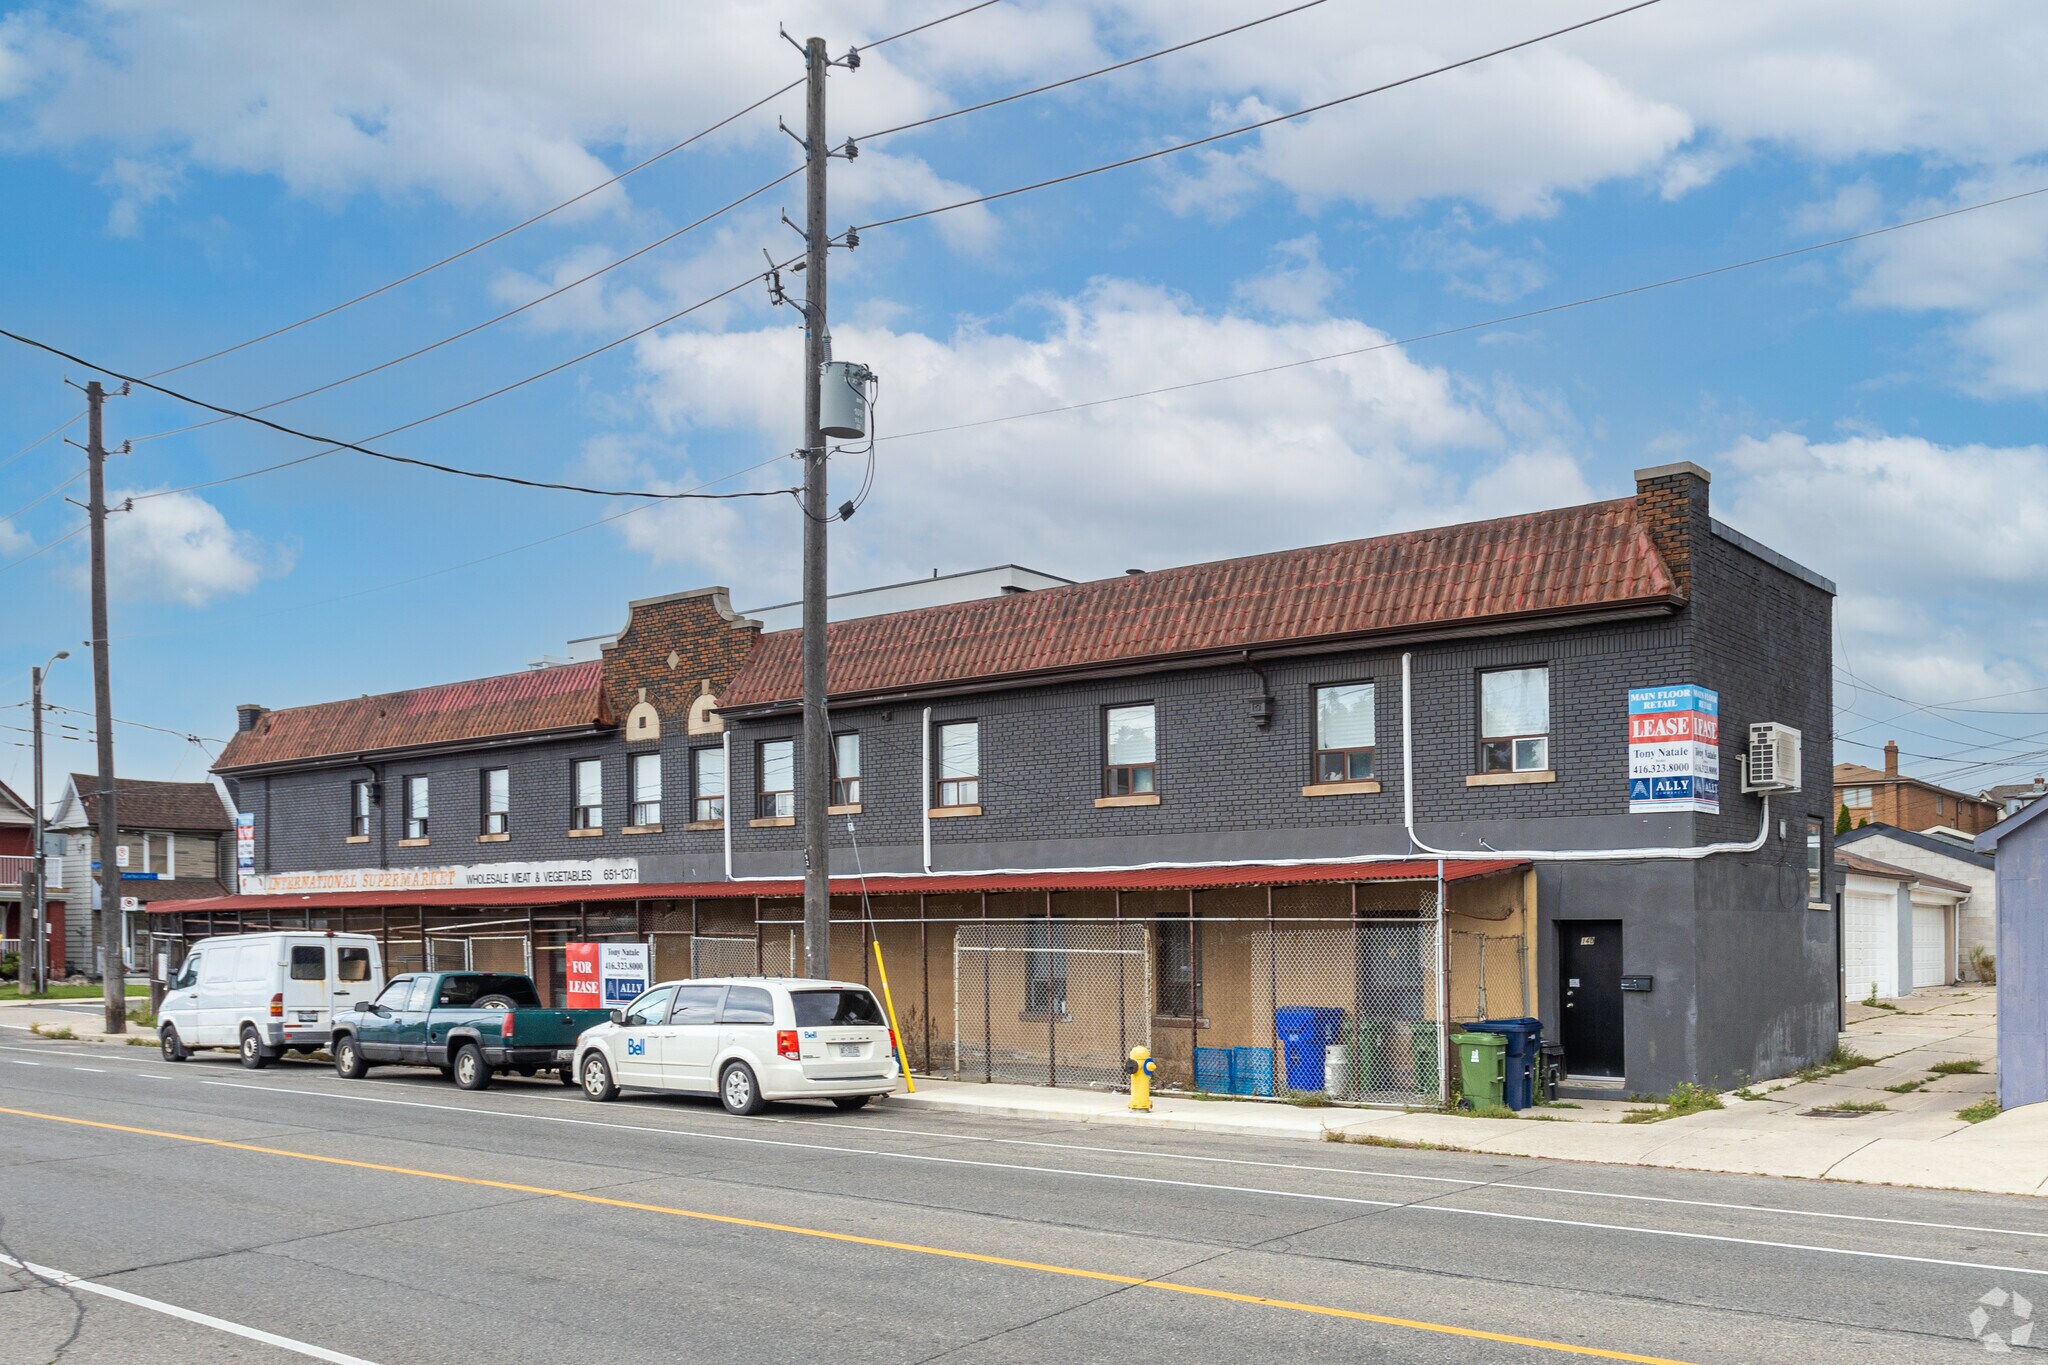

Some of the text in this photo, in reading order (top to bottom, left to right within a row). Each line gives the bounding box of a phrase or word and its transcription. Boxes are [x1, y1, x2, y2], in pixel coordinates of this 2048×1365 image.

[1631, 689, 1691, 701] MAIN FLOOR
[1643, 700, 1678, 709] RETAIL
[1632, 717, 1689, 738] LEASE
[1693, 717, 1718, 739] LEASE
[1633, 747, 1689, 760] Tony Natale
[1633, 763, 1689, 774] 416.323.8000
[1656, 780, 1689, 791] ALLY
[268, 868, 637, 890] INTERNATIONAL SUPERMARKET WHOLESALE MEAT & VEGETABLES 651-1371
[607, 948, 620, 957] Tony
[572, 961, 592, 973] FOR
[569, 981, 598, 993] LEASE
[620, 984, 642, 993] ALLY
[628, 1038, 645, 1055] Bell
